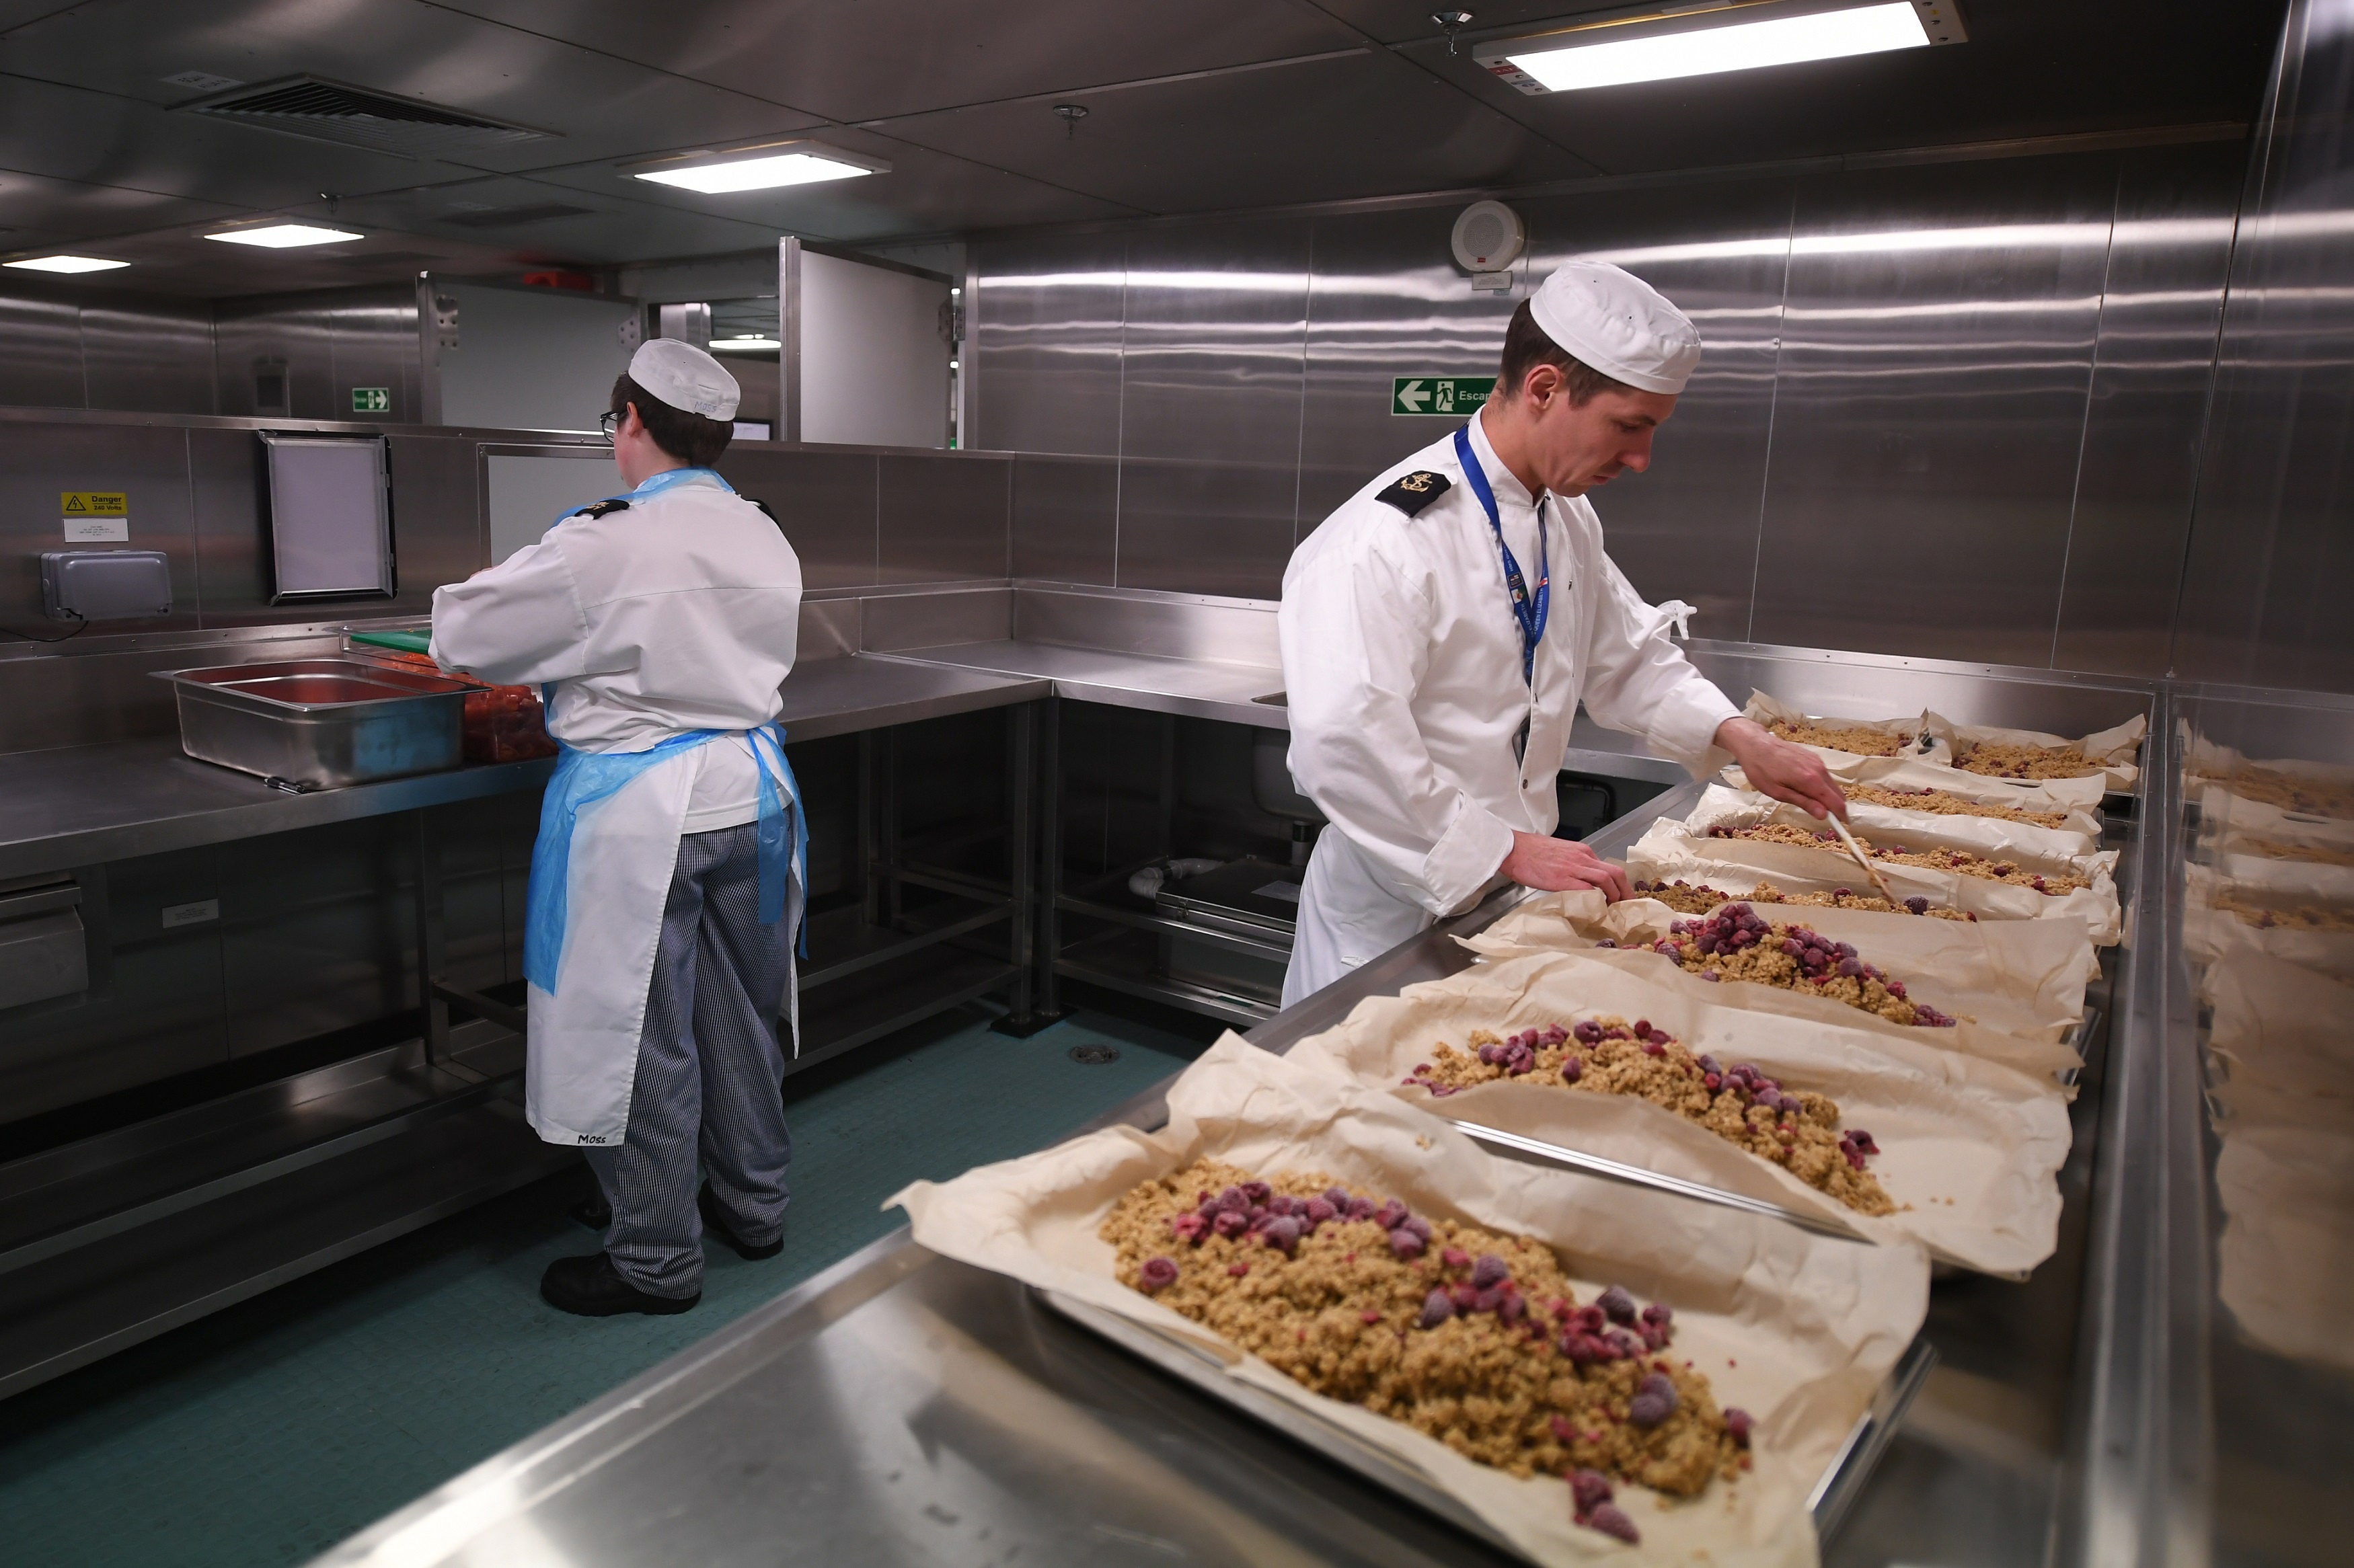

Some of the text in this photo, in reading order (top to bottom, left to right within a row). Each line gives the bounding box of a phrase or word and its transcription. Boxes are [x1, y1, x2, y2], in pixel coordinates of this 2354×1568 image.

[1459, 390, 1490, 401] Escap
[694, 401, 717, 412] MOSS
[91, 496, 122, 504] Danger
[1521, 603, 1533, 631] ELIZABETH
[578, 1134, 607, 1144] Moss
